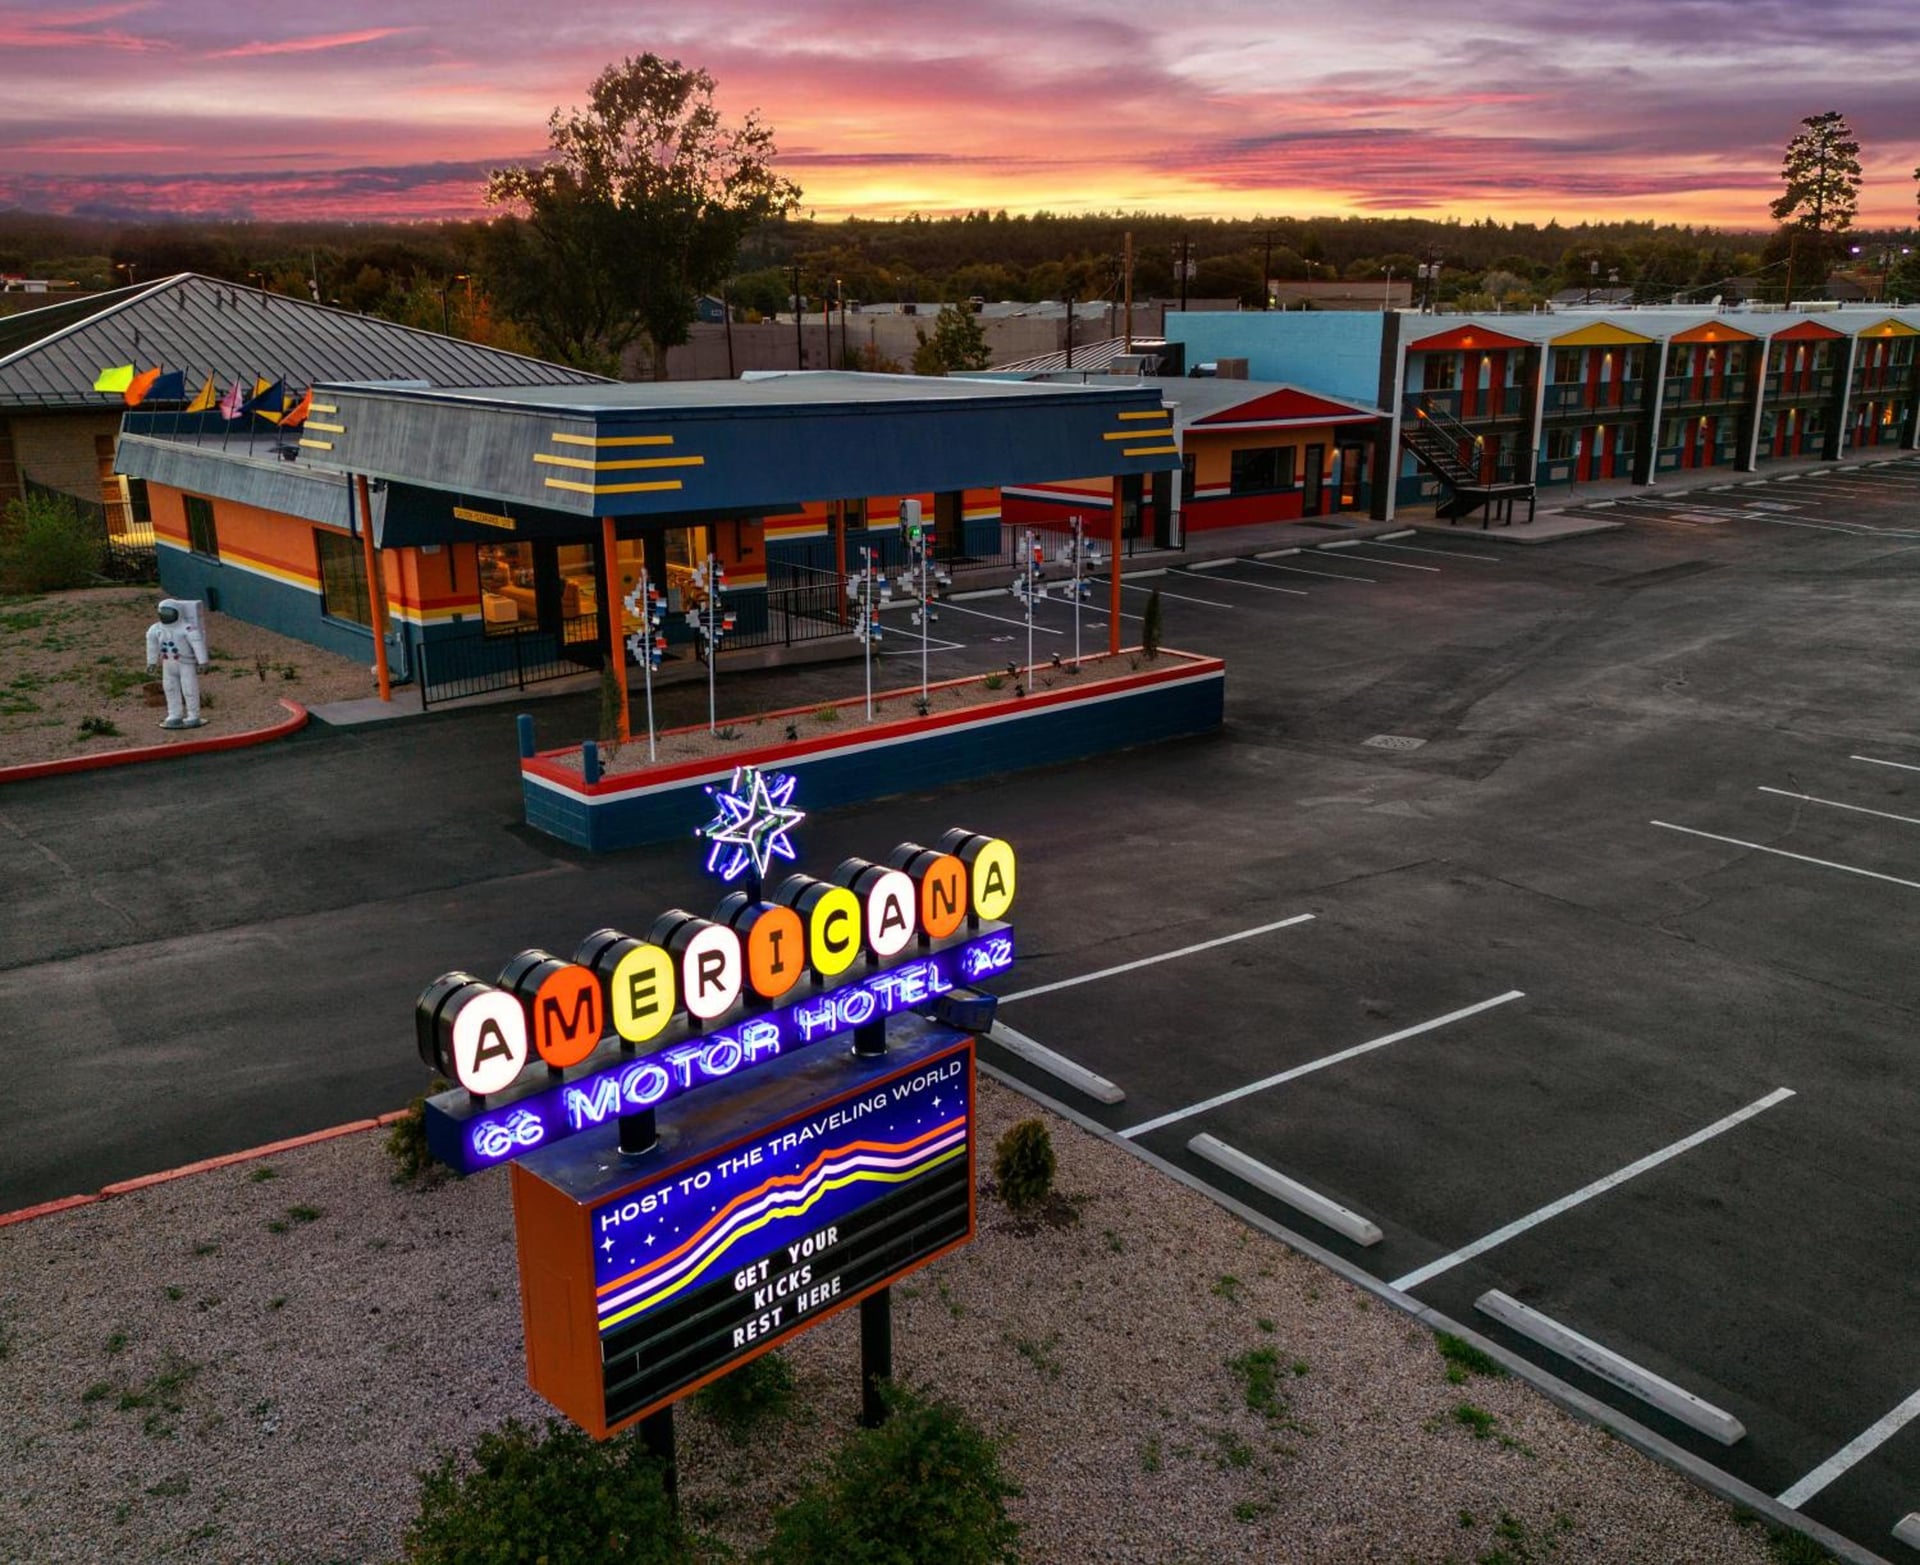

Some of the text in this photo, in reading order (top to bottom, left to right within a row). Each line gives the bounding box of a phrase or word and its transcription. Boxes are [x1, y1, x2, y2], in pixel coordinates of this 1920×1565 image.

[470, 858, 1009, 1075] AMERICANA
[478, 940, 1012, 1158] 66 MOTOR HOTEL AZ
[601, 1061, 962, 1232] HOST TO THE TRAVELING WORLD
[733, 1226, 838, 1292] GET YOUR
[733, 1276, 841, 1348] REST HERE
[754, 1264, 812, 1310] KICKS
